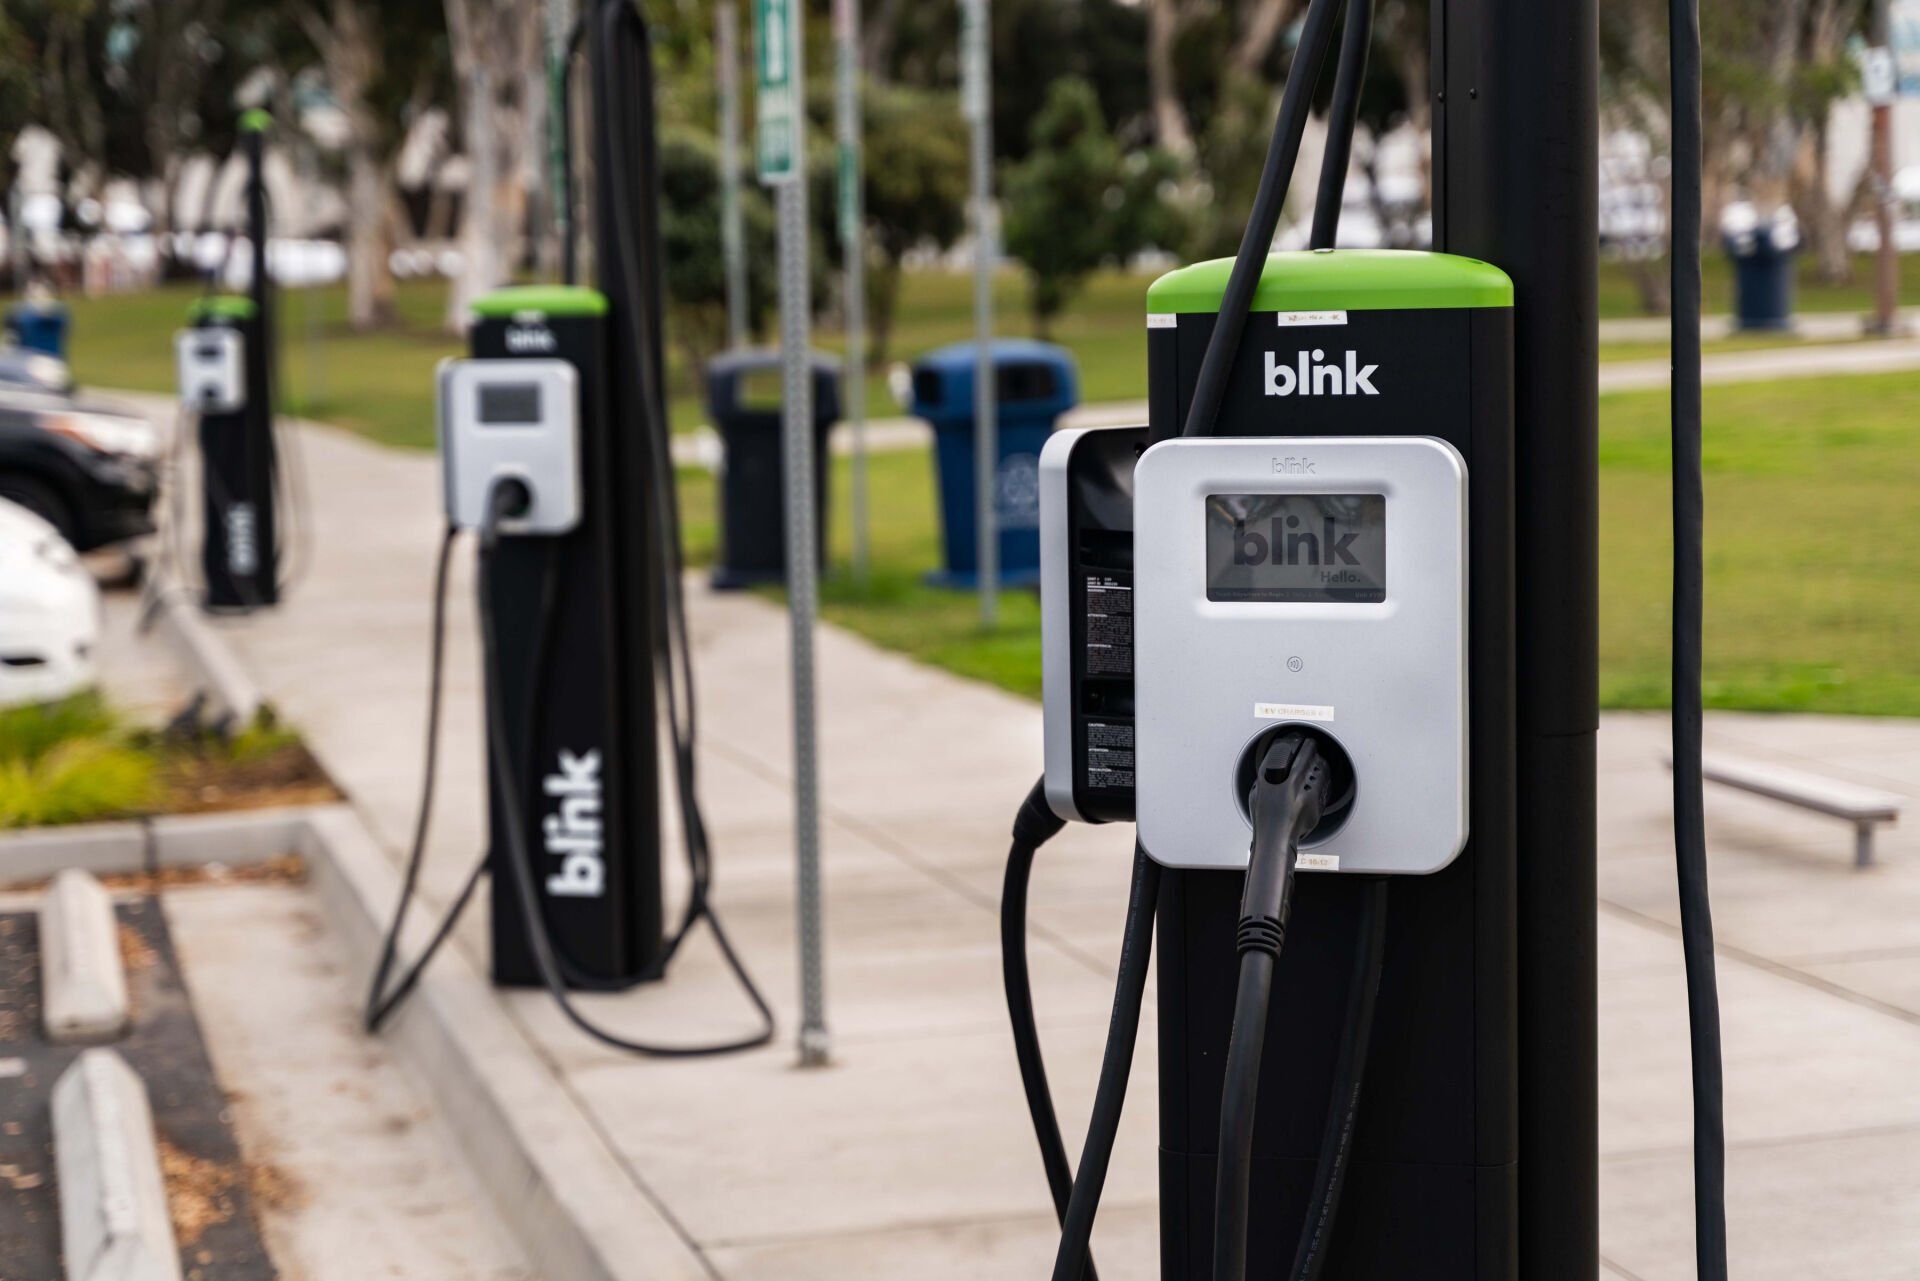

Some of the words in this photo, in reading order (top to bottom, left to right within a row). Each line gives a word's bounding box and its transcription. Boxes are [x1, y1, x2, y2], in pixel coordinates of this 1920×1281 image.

[1264, 349, 1380, 396] blink
[1272, 457, 1315, 474] blink
[1234, 515, 1361, 566] blink
[1321, 570, 1360, 583] Hello.
[543, 748, 605, 896] blink
